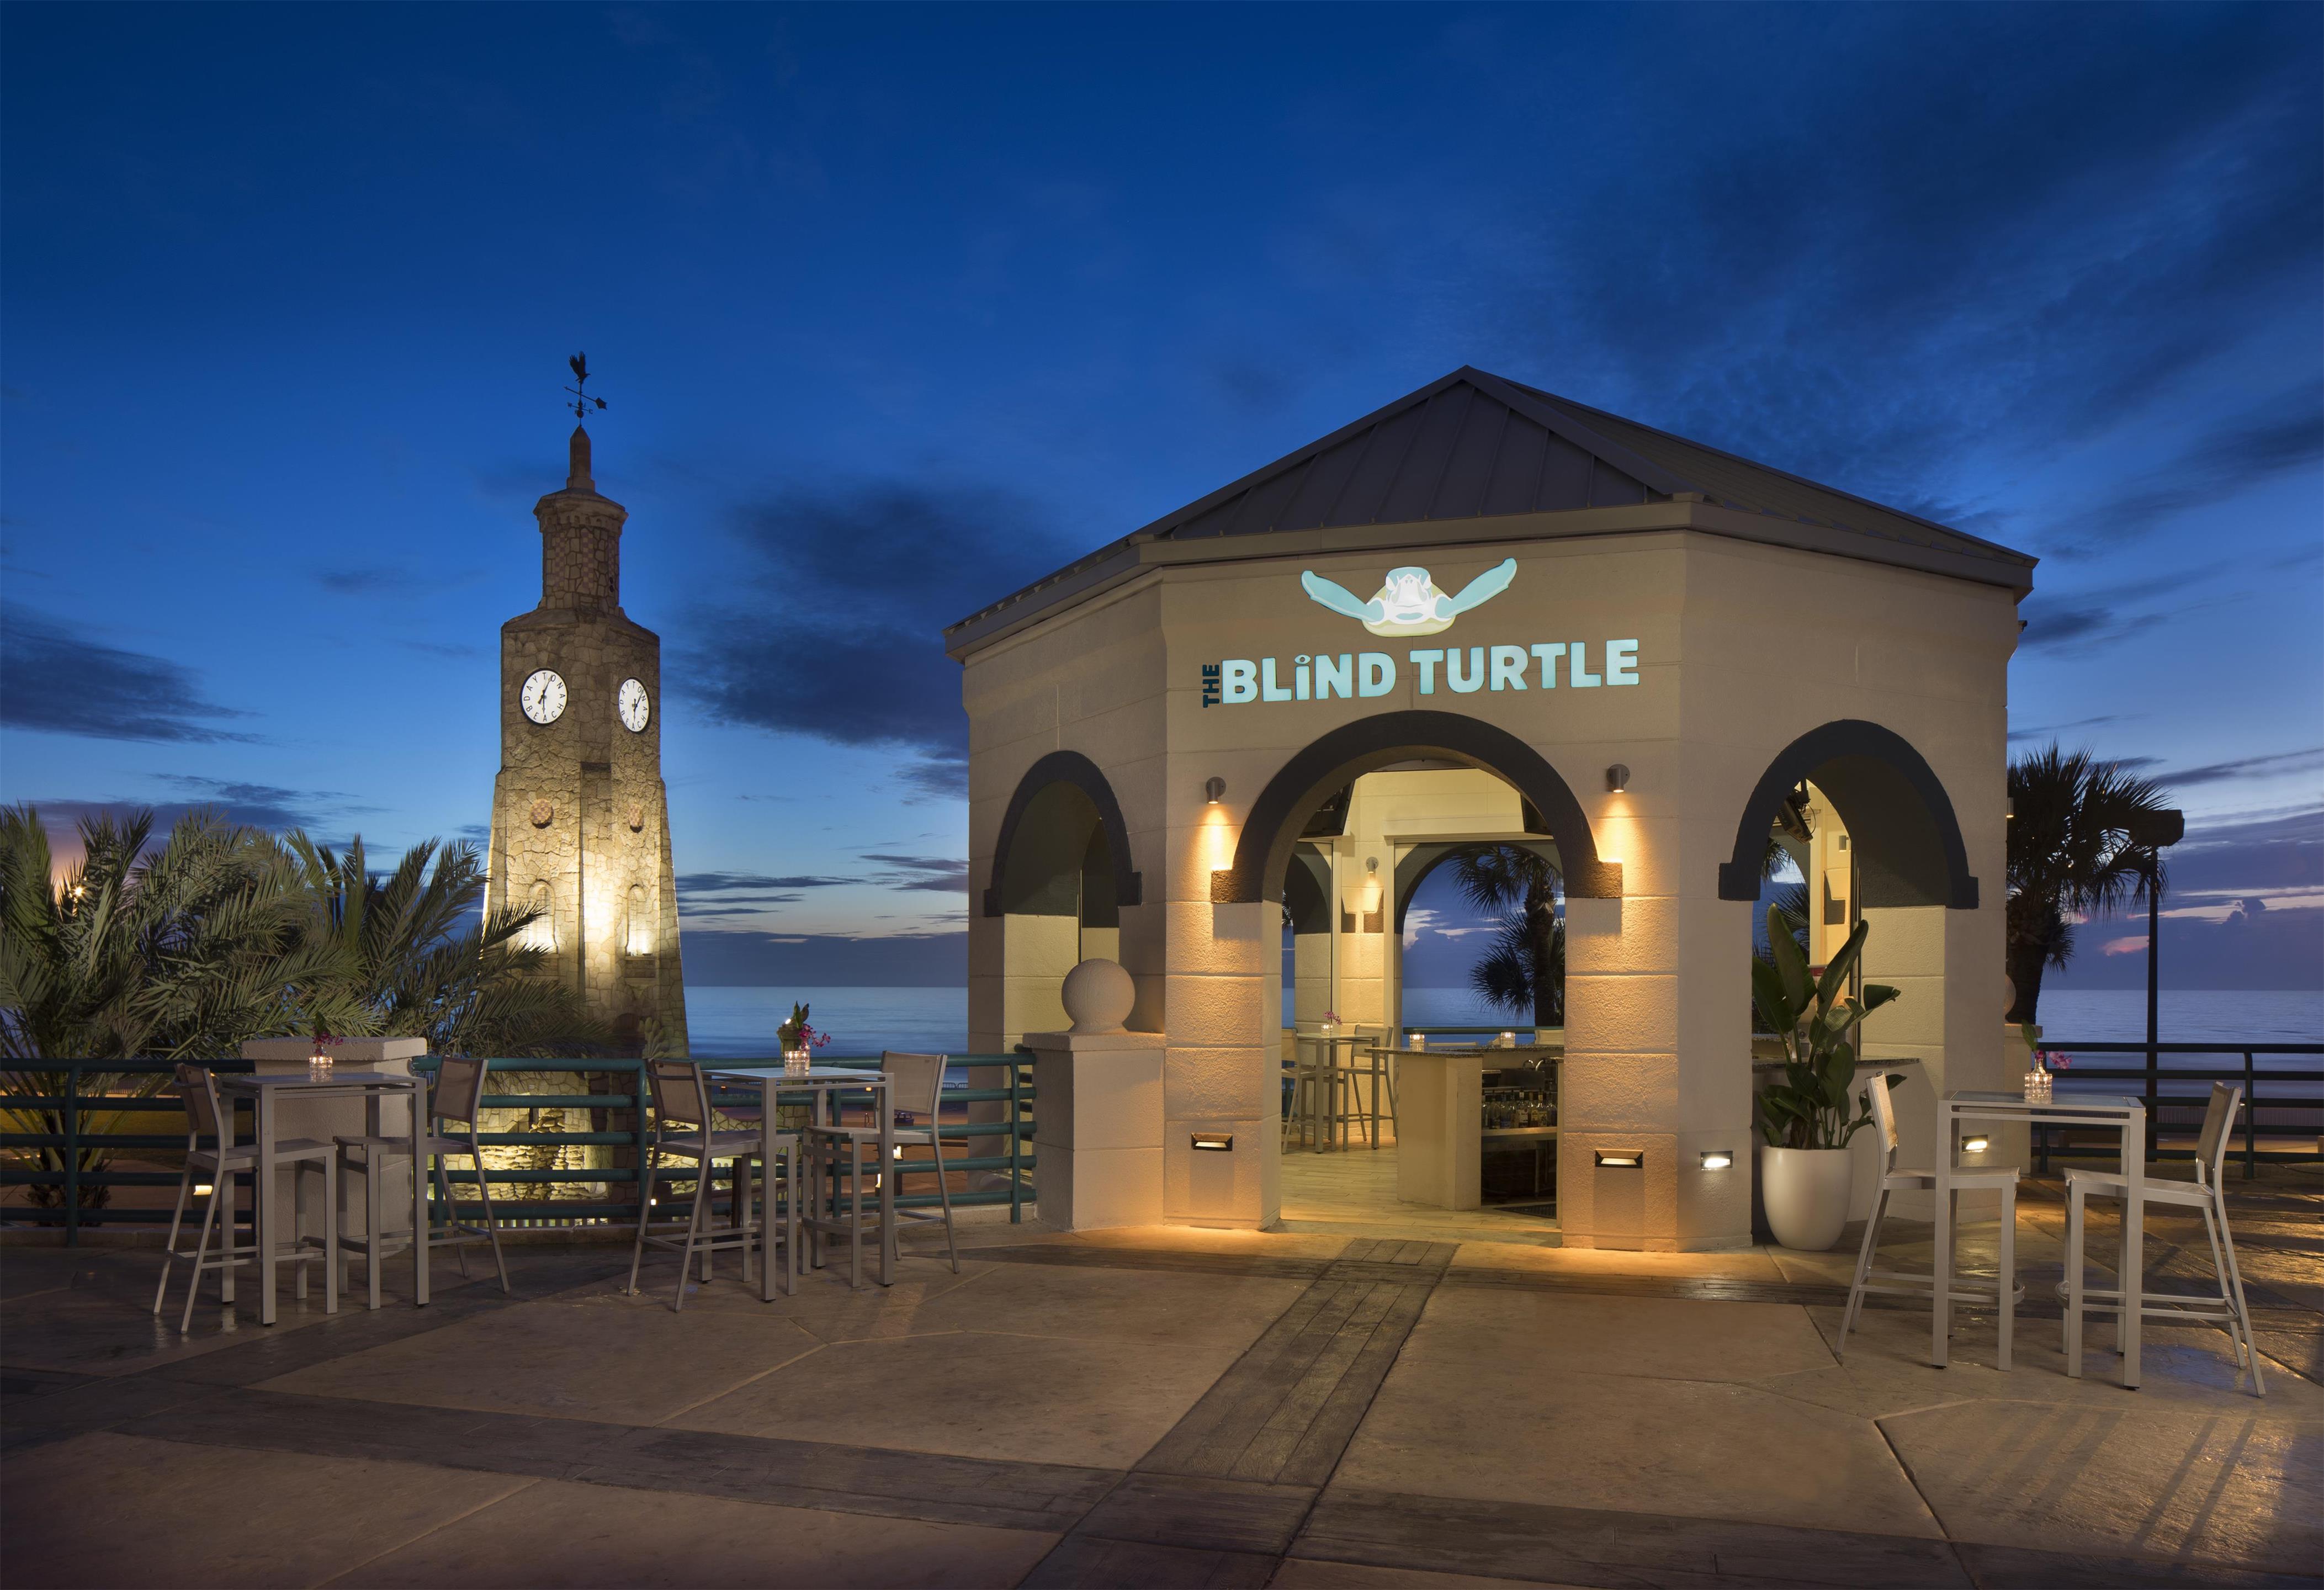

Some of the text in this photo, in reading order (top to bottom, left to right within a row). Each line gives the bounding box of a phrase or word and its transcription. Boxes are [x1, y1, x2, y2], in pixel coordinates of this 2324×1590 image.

[523, 672, 566, 701] DAYTONA
[1202, 664, 1220, 708] THE
[1409, 638, 1640, 695] TURTLE
[619, 681, 648, 711] DAYTONA
[526, 703, 564, 722] BEACH
[620, 711, 646, 730] BEACH
